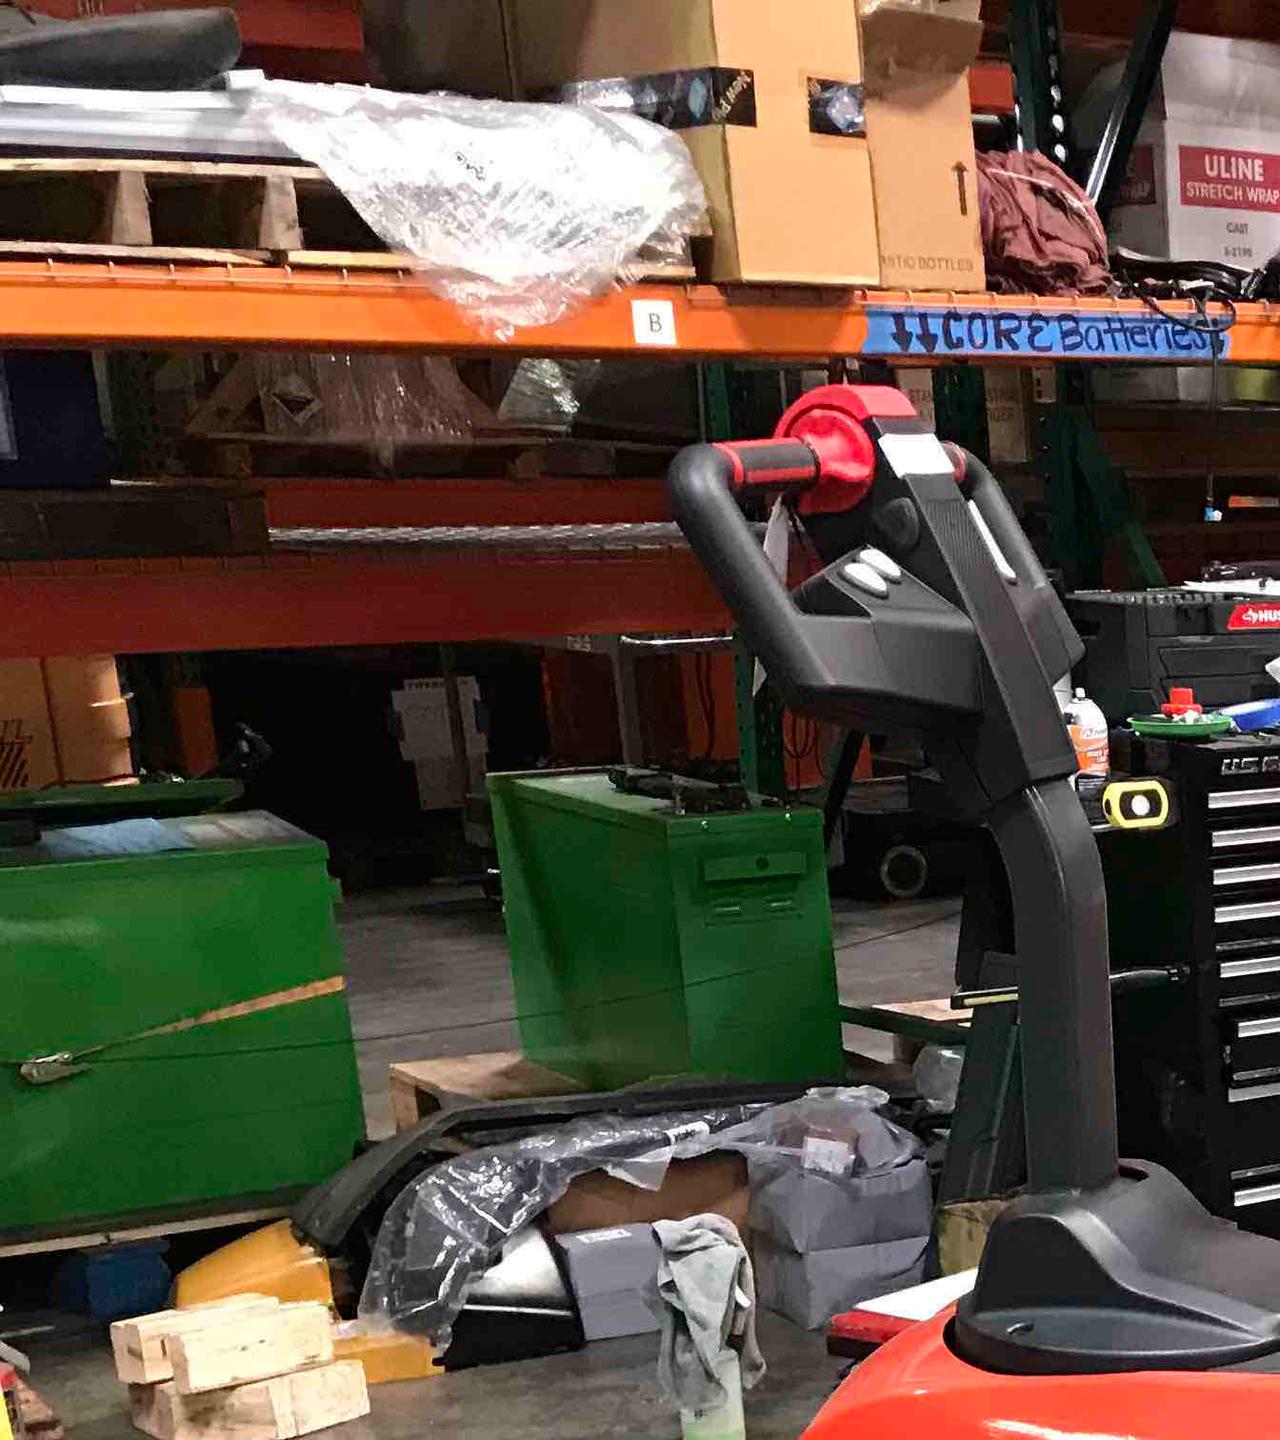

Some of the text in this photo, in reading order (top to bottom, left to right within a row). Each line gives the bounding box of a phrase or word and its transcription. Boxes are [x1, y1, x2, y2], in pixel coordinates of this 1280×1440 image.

[1204, 154, 1264, 181] ULINE
[1186, 181, 1280, 204] STRETCH WRAP
[649, 312, 662, 332] B
[942, 310, 1208, 352] CORE Batteries
